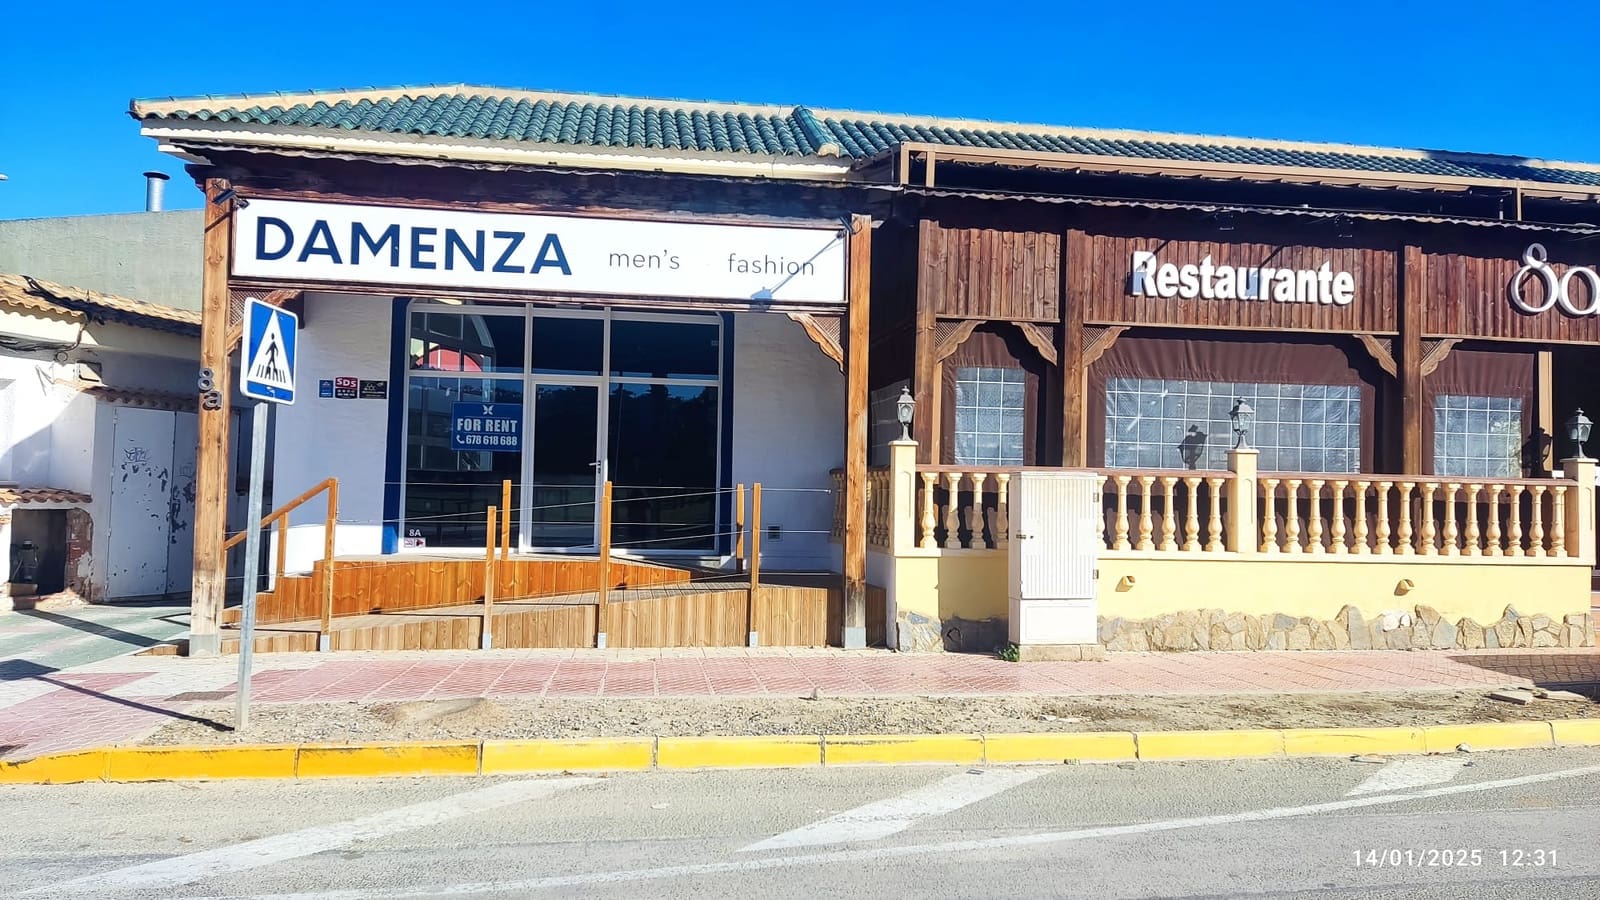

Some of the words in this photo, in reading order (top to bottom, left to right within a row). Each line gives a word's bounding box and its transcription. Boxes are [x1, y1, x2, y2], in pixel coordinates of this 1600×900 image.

[255, 216, 572, 276] DAMENZA
[727, 252, 816, 277] fashion
[1131, 250, 1356, 306] Restaurante
[336, 377, 357, 388] SDS
[457, 418, 481, 432] FOR
[485, 419, 518, 433] RENT
[465, 434, 482, 445] 678
[483, 435, 499, 446] 618
[500, 436, 518, 446] 688
[409, 528, 421, 537] 8A
